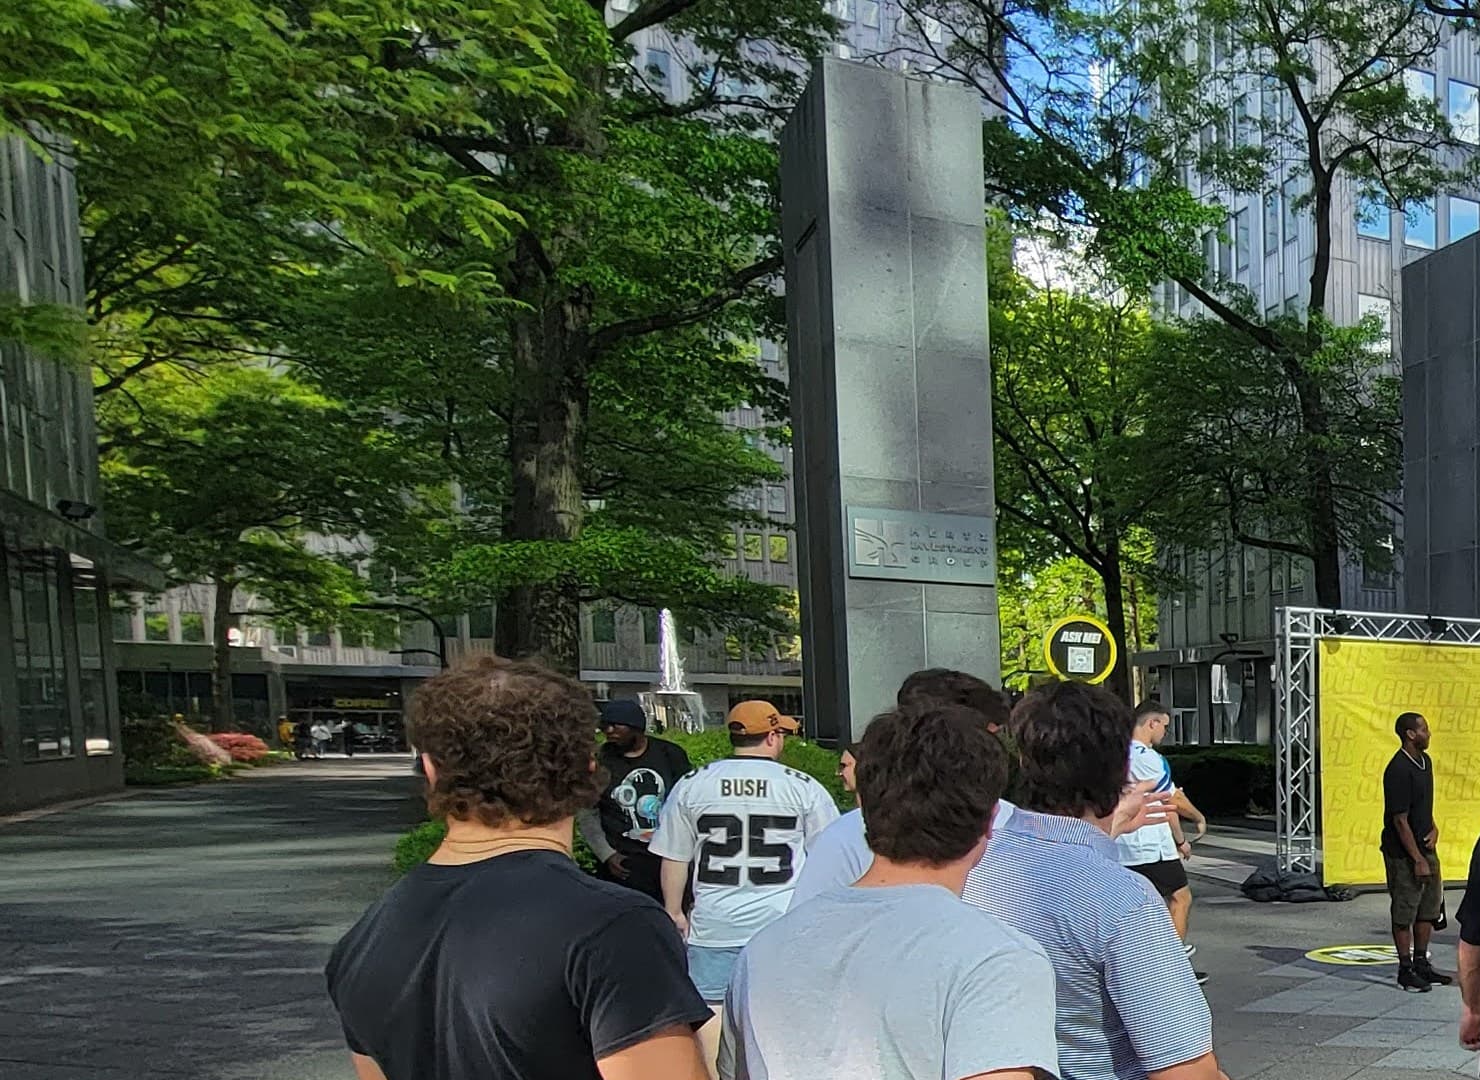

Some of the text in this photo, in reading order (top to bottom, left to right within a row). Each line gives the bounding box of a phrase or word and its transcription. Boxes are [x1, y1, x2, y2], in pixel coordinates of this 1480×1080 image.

[1060, 631, 1083, 643] ASK
[720, 779, 768, 798] BUSH
[697, 813, 798, 886] 25
